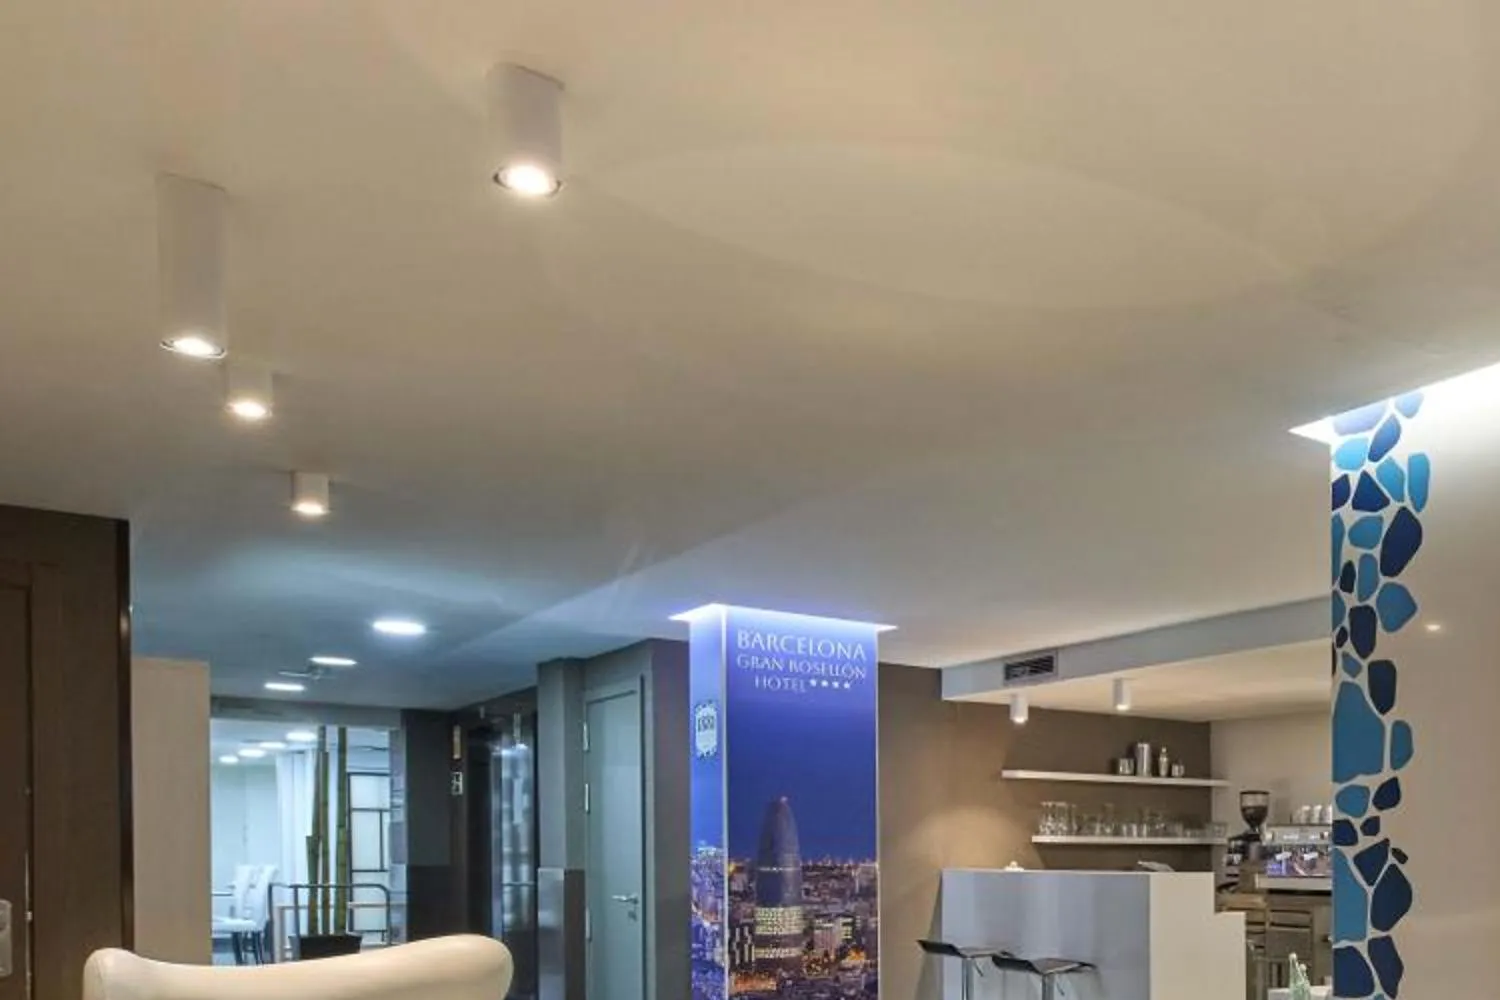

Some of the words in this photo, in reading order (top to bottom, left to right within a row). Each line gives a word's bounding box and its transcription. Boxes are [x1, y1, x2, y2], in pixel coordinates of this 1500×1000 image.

[738, 630, 866, 660] BARCELONA
[737, 654, 784, 672] GRAN
[755, 675, 806, 692] HOTEL
